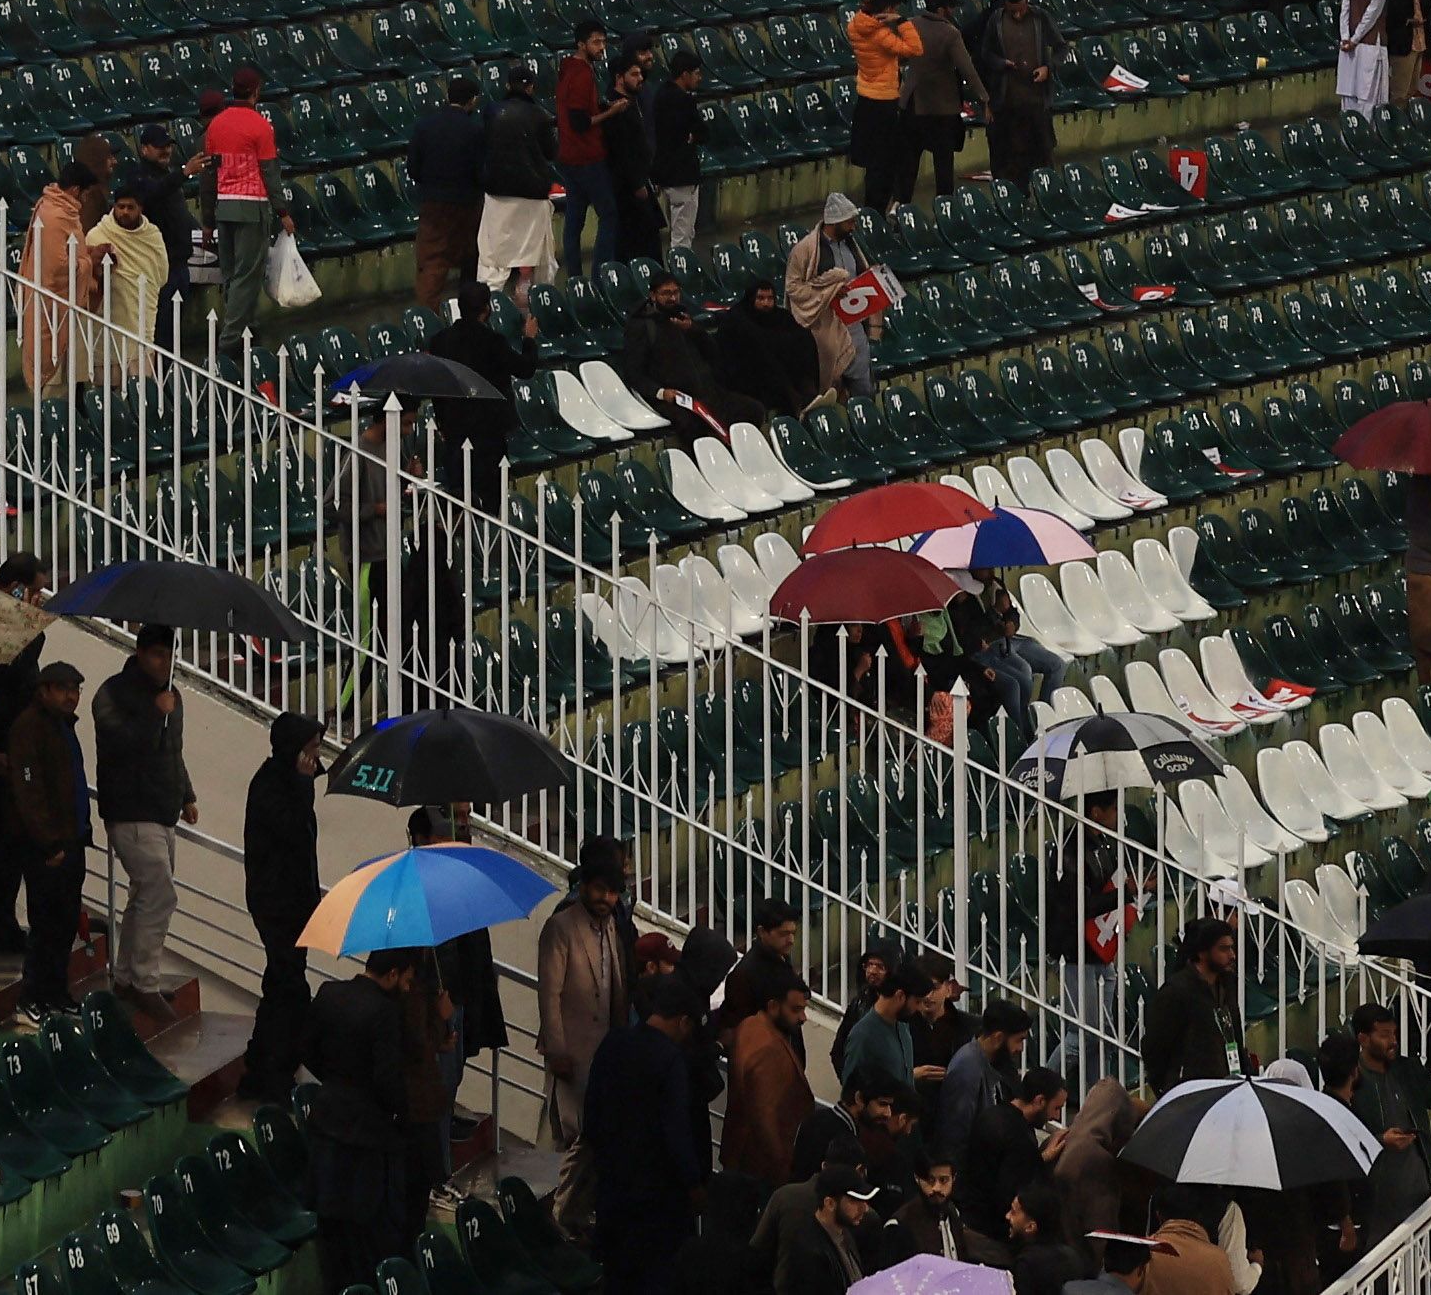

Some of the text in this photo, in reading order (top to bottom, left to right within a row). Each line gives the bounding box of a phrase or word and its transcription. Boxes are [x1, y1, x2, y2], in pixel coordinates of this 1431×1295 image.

[1178, 157, 1199, 191] 4
[351, 764, 396, 792] 5.11
[7, 1055, 21, 1075] 73
[69, 1247, 84, 1268] 68
